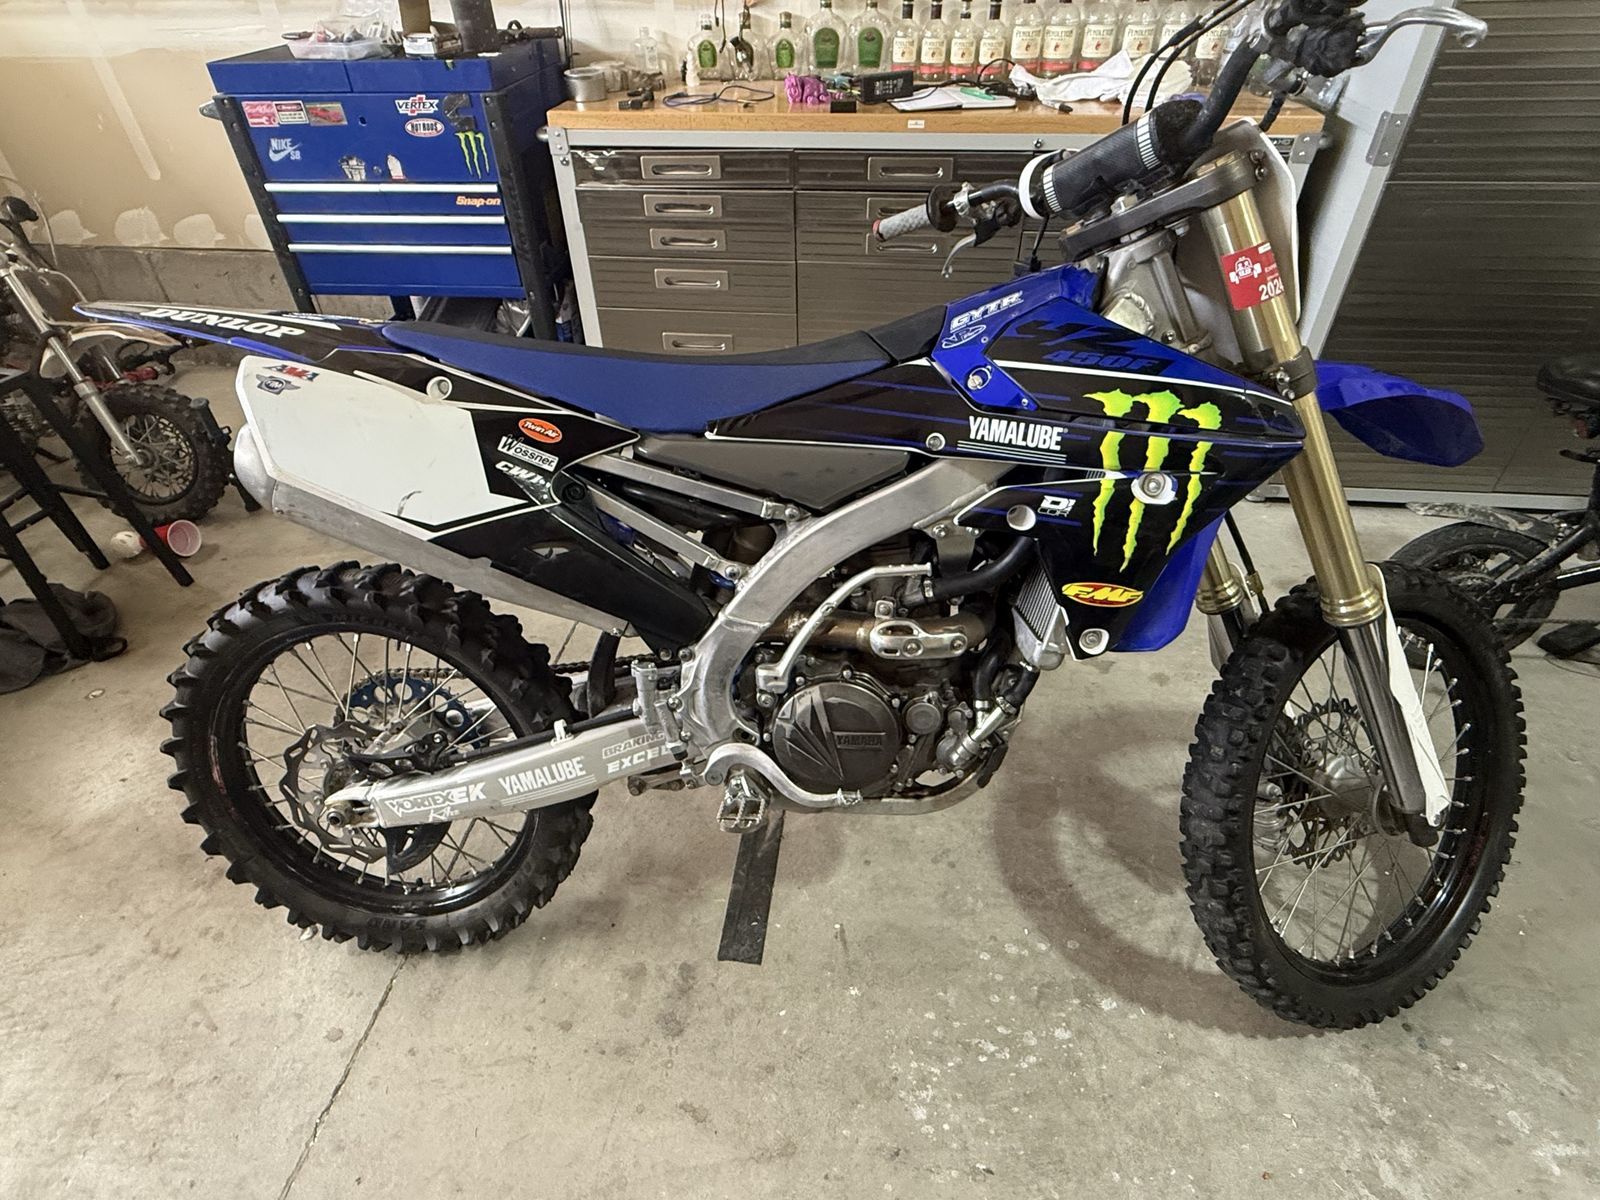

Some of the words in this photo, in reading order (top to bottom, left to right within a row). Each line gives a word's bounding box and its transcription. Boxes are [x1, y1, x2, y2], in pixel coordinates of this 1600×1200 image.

[396, 101, 436, 110] VERTEX
[270, 138, 292, 151] NIKE
[290, 150, 301, 160] SB
[456, 195, 501, 208] Snap-on
[950, 290, 1024, 332] GYTR
[140, 307, 306, 338] DUNLOP
[1041, 350, 1160, 371] 450F
[522, 420, 546, 434] Twin
[968, 415, 1064, 451] YAMALUBE
[1062, 584, 1144, 602] FMF
[604, 730, 667, 758] BRAKING
[607, 745, 671, 774] EXCEL
[498, 756, 586, 795] YAMALUBE
